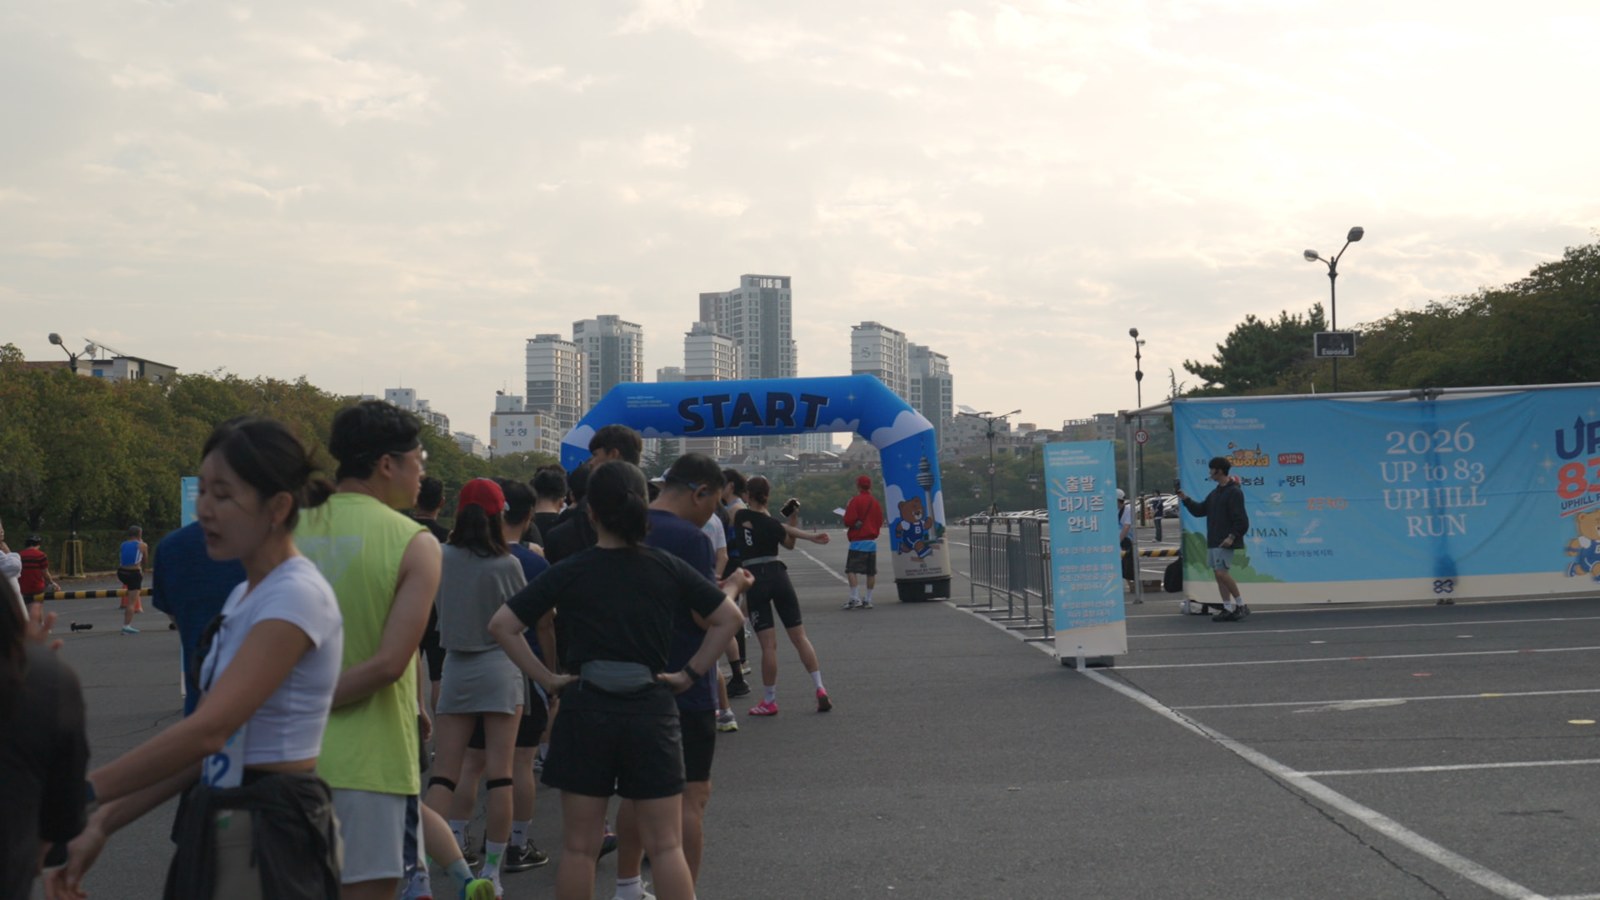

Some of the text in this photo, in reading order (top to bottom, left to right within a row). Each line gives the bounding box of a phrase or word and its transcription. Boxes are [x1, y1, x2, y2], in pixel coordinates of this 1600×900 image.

[677, 391, 831, 433] START
[1385, 421, 1475, 455] 2026
[1241, 476, 1265, 486] 농심
[1379, 458, 1486, 484] UP to 83
[1065, 475, 1096, 493] 출발
[1058, 495, 1105, 512] 대기존
[1382, 485, 1487, 511] UPHILL
[1560, 496, 1594, 511] UPHILL
[1067, 515, 1099, 533] 안내
[1406, 513, 1468, 538] RUN
